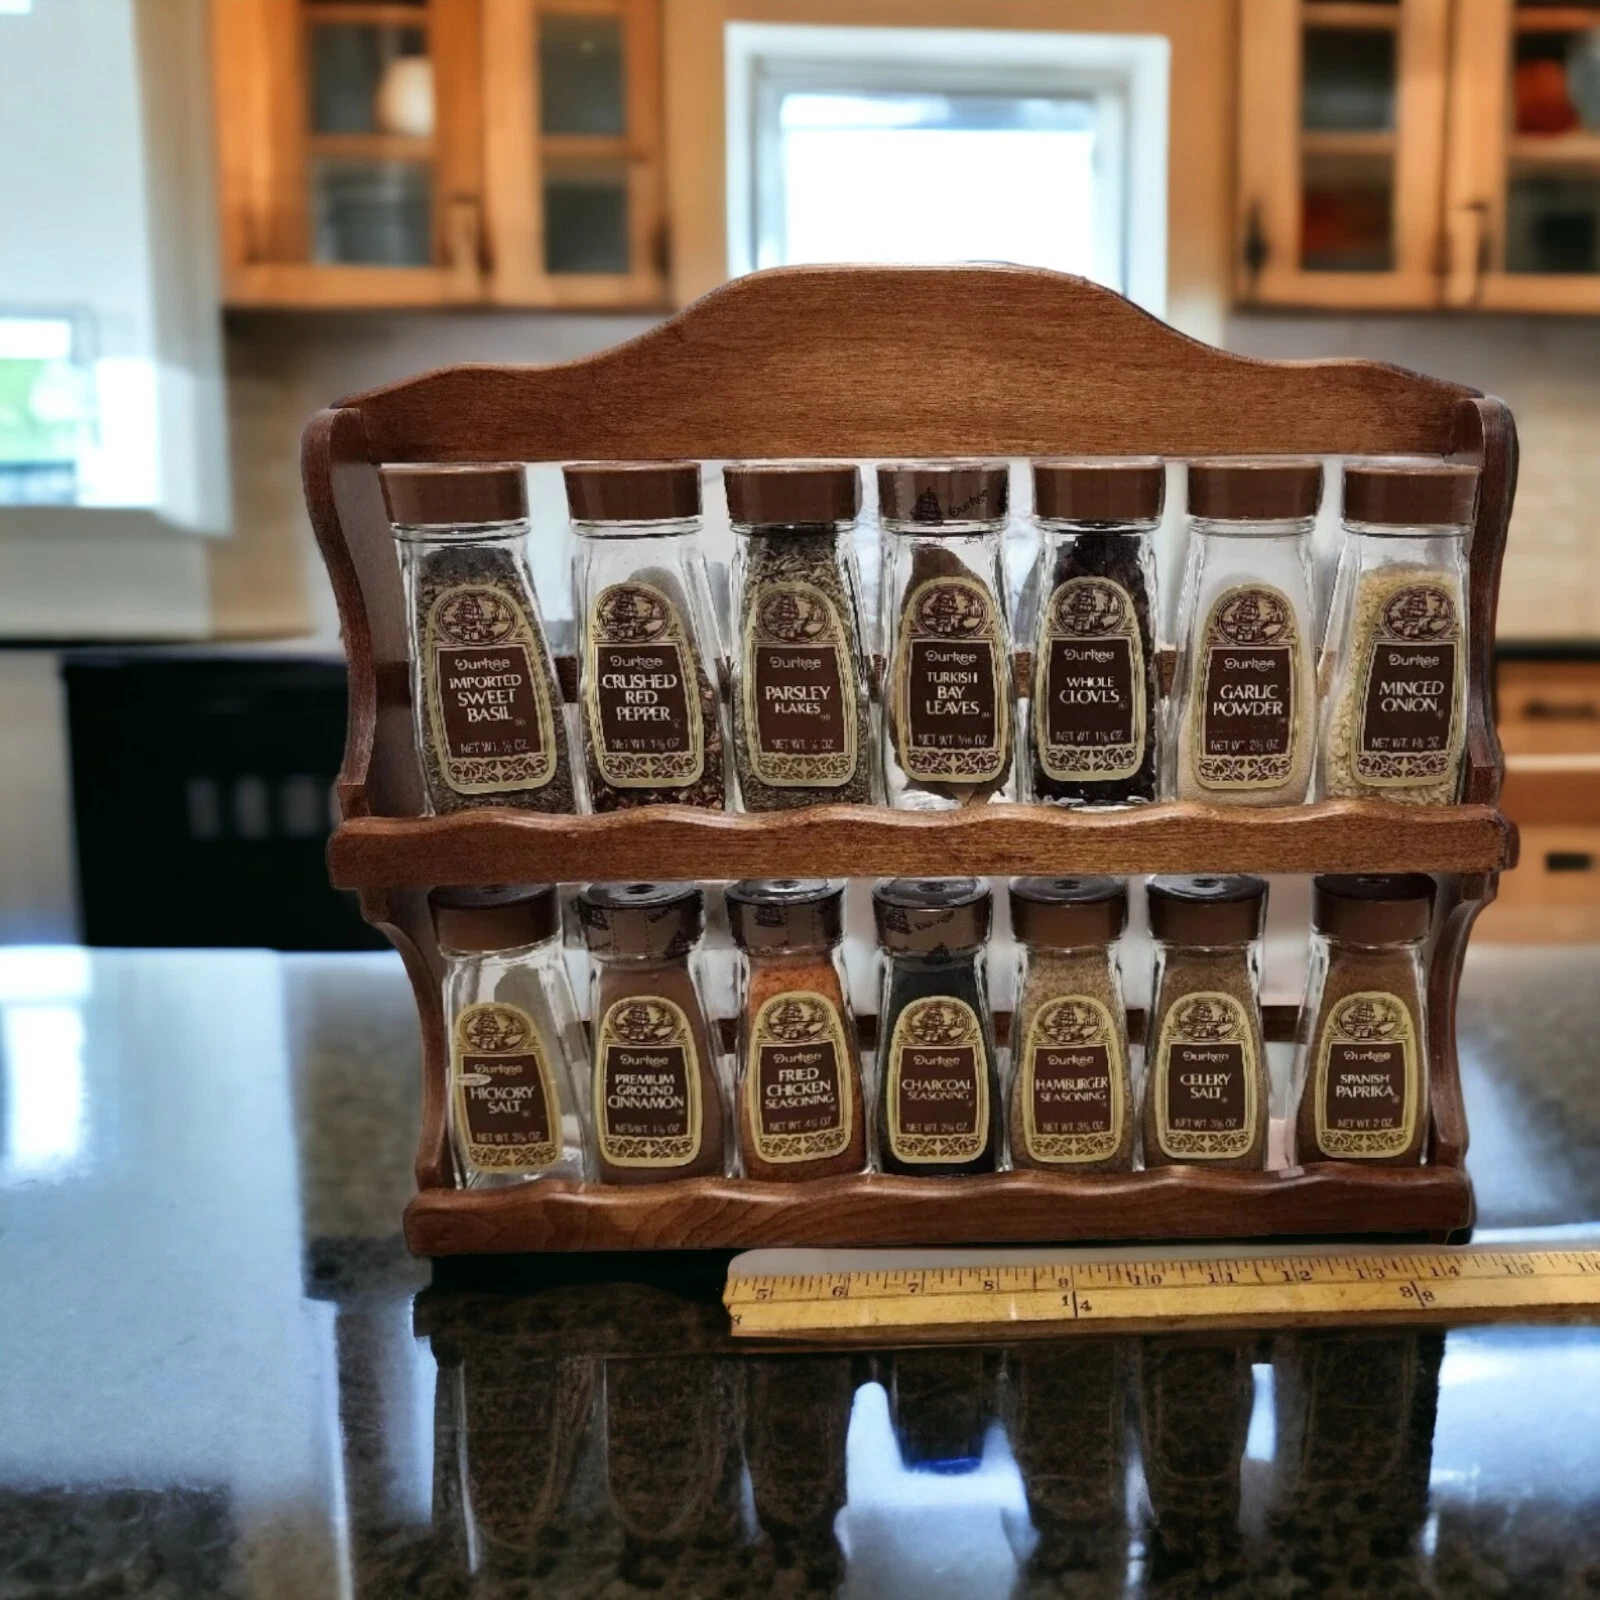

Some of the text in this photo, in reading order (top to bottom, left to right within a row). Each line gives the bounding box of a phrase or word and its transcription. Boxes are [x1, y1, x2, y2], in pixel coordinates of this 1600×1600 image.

[925, 651, 977, 665] Durkee
[1064, 649, 1114, 663] Durkee
[1389, 654, 1439, 668] Durkee
[455, 658, 510, 671] Durkee
[610, 656, 663, 670] Durkee
[769, 656, 821, 670] Durkee
[1224, 658, 1276, 671] Durkee
[450, 674, 522, 689] IMPORTED
[602, 674, 678, 688] CRUSHED
[926, 672, 978, 684] TURKISH
[1066, 676, 1114, 688] WHOLE
[765, 686, 831, 700] PARSLEY
[937, 686, 966, 699] BAY
[1220, 685, 1278, 700] GARLIC
[1379, 681, 1444, 695] MINCED
[458, 688, 516, 706] SWEET
[625, 690, 658, 704] RED
[1059, 690, 1119, 704] CLOVES
[774, 702, 820, 715] FLAKES
[926, 701, 979, 715] LEAVES
[1213, 702, 1283, 716] POWDER
[1382, 698, 1438, 712] ONION
[468, 706, 513, 722] BASIL
[616, 706, 671, 722] PEPPER
[918, 734, 937, 745] NET
[1056, 730, 1074, 741] NET
[460, 742, 479, 753] NET
[612, 739, 628, 750] NET
[771, 739, 789, 750] NET
[1211, 740, 1230, 750] NET
[1372, 737, 1390, 748] NET
[620, 1054, 668, 1067] Durkee
[773, 1052, 822, 1064] Durkee
[913, 1055, 960, 1068] Durkee
[1048, 1055, 1094, 1067] Durkee
[1182, 1052, 1229, 1063] Durkee
[1344, 1051, 1391, 1062] Durkee
[615, 1074, 675, 1085] PREMIUM
[778, 1068, 819, 1082] FRIED
[1180, 1073, 1232, 1085] CELERY
[1340, 1074, 1390, 1084] SPANISH
[767, 1080, 831, 1097] CHICKEN
[902, 1079, 974, 1091] CHARCOAL
[1036, 1076, 1108, 1091] HAMBURGER
[470, 1086, 535, 1100] HICKORY
[616, 1085, 673, 1096] GROUND
[908, 1090, 969, 1100] SEASONING
[1040, 1091, 1106, 1102] SEASONING
[1191, 1087, 1222, 1099] SALT
[1336, 1086, 1395, 1098] PAPRIKA
[488, 1100, 522, 1114] SALT
[608, 1096, 684, 1109] CINNAMON
[765, 1094, 835, 1109] SEASONING
[769, 1121, 786, 1132] NET
[906, 1123, 922, 1132] NET
[1042, 1123, 1059, 1132] NET
[1175, 1119, 1192, 1128] NET
[1337, 1119, 1353, 1128] NET
[1373, 1119, 1379, 1128] 2
[477, 1133, 494, 1144] NET
[756, 1289, 768, 1300] 5
[832, 1286, 844, 1297] 6
[908, 1282, 920, 1294] 7
[983, 1280, 994, 1291] 8
[1057, 1277, 1069, 1287] 9
[1132, 1274, 1162, 1286] 10
